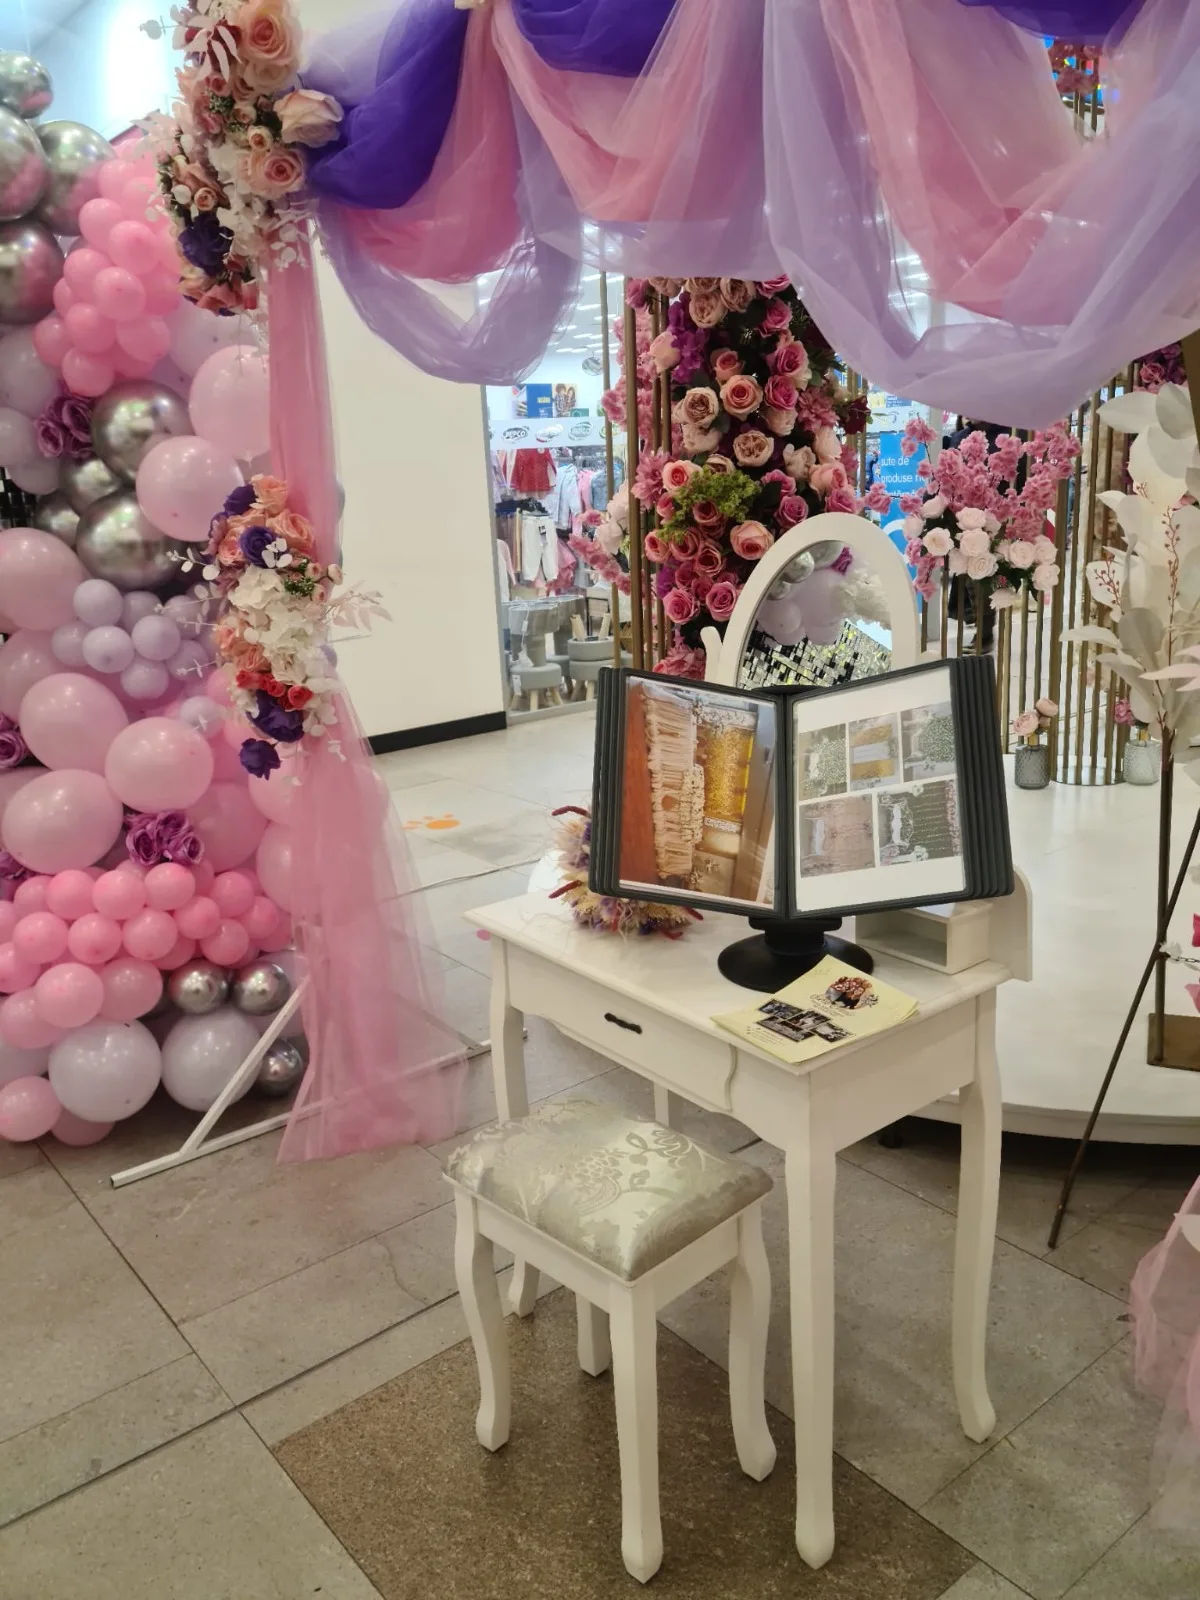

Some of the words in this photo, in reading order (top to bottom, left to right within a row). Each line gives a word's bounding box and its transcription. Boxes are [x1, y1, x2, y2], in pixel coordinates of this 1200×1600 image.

[881, 457, 896, 466] sute
[898, 456, 909, 466] de
[881, 472, 913, 483] produse
